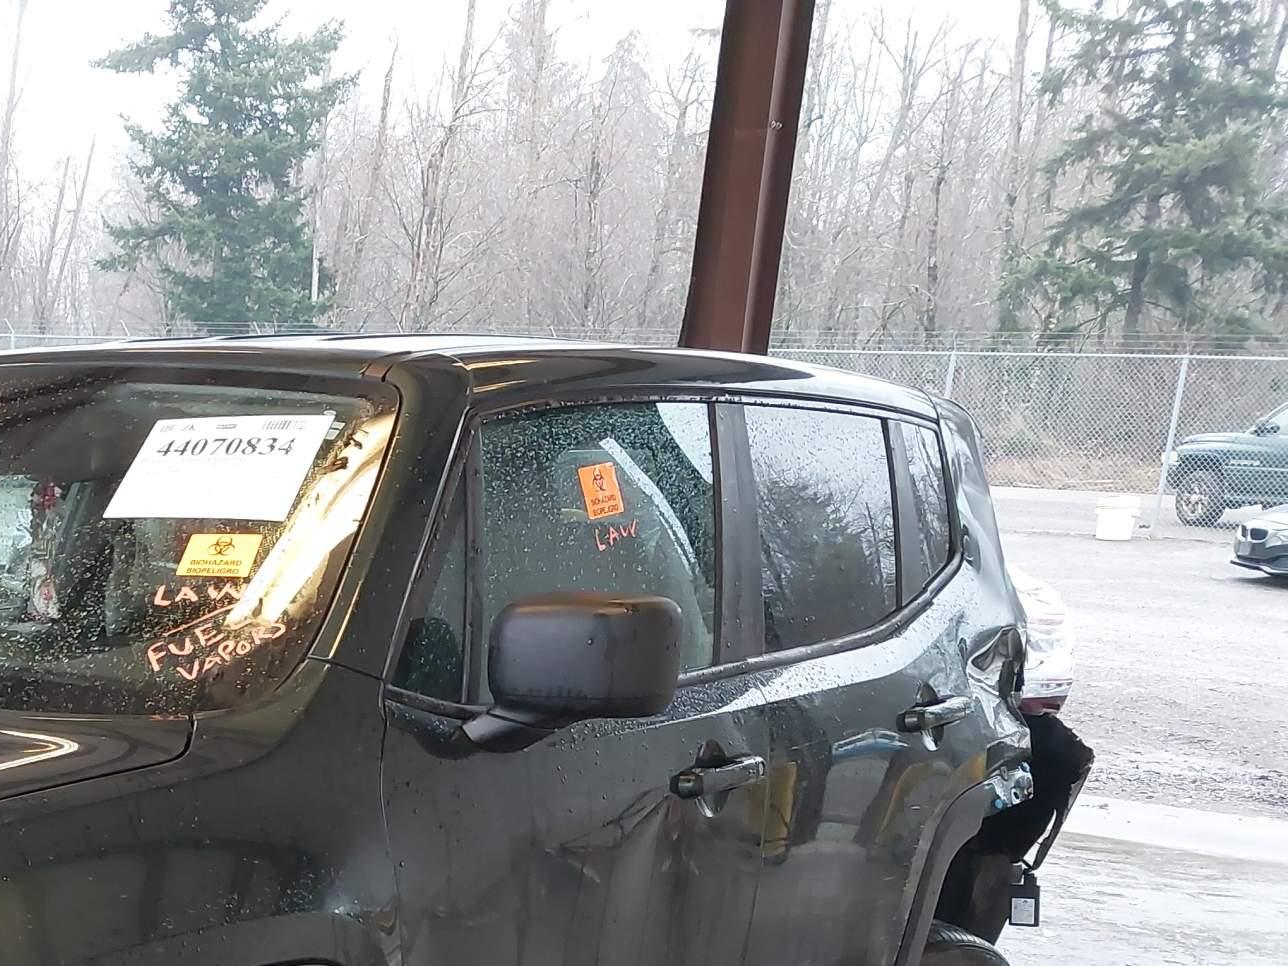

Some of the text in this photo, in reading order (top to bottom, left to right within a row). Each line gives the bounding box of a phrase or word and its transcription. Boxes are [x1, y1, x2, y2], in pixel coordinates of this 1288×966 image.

[157, 437, 296, 456] 44070834
[595, 518, 638, 552] LAW
[186, 567, 240, 575] BIOPELIGRO
[190, 559, 243, 567] BIOHAZARD
[153, 582, 248, 606] LAW
